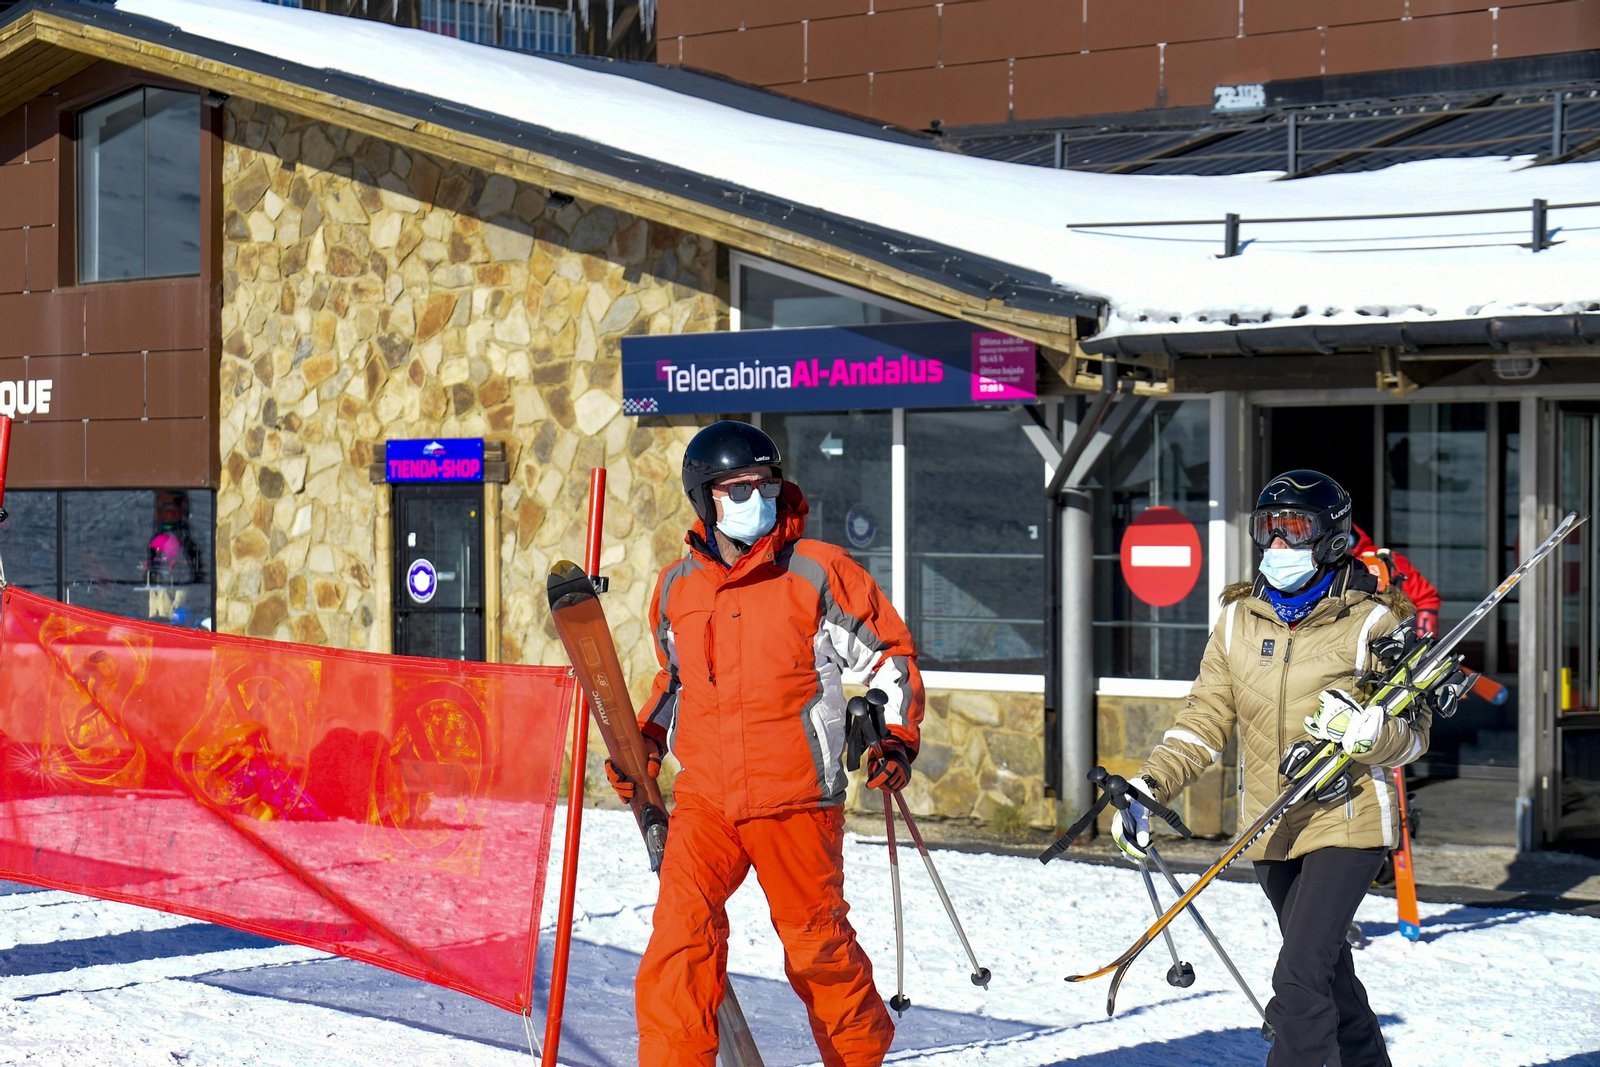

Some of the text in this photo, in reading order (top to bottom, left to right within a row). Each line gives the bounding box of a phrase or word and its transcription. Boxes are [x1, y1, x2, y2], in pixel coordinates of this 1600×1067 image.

[0, 379, 53, 419] QUE
[388, 458, 481, 479] TIENDA-SHOP
[591, 690, 611, 727] ATOMIC
